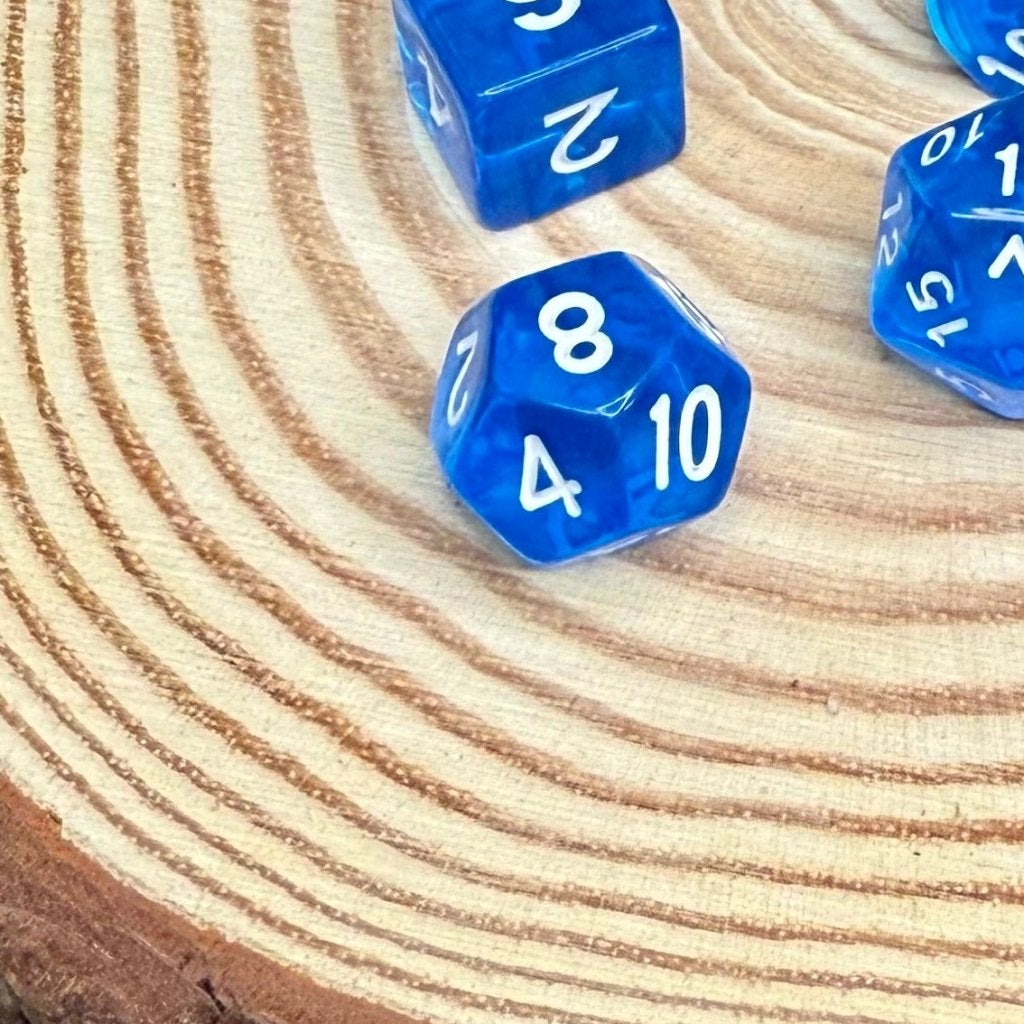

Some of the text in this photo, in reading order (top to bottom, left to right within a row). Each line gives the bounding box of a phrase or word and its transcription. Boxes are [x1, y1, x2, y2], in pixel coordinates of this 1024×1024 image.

[543, 87, 620, 174] 2
[920, 112, 984, 167] 10
[537, 291, 614, 375] 8
[905, 270, 969, 348] 15
[519, 434, 582, 518] 4
[649, 384, 722, 491] 10
